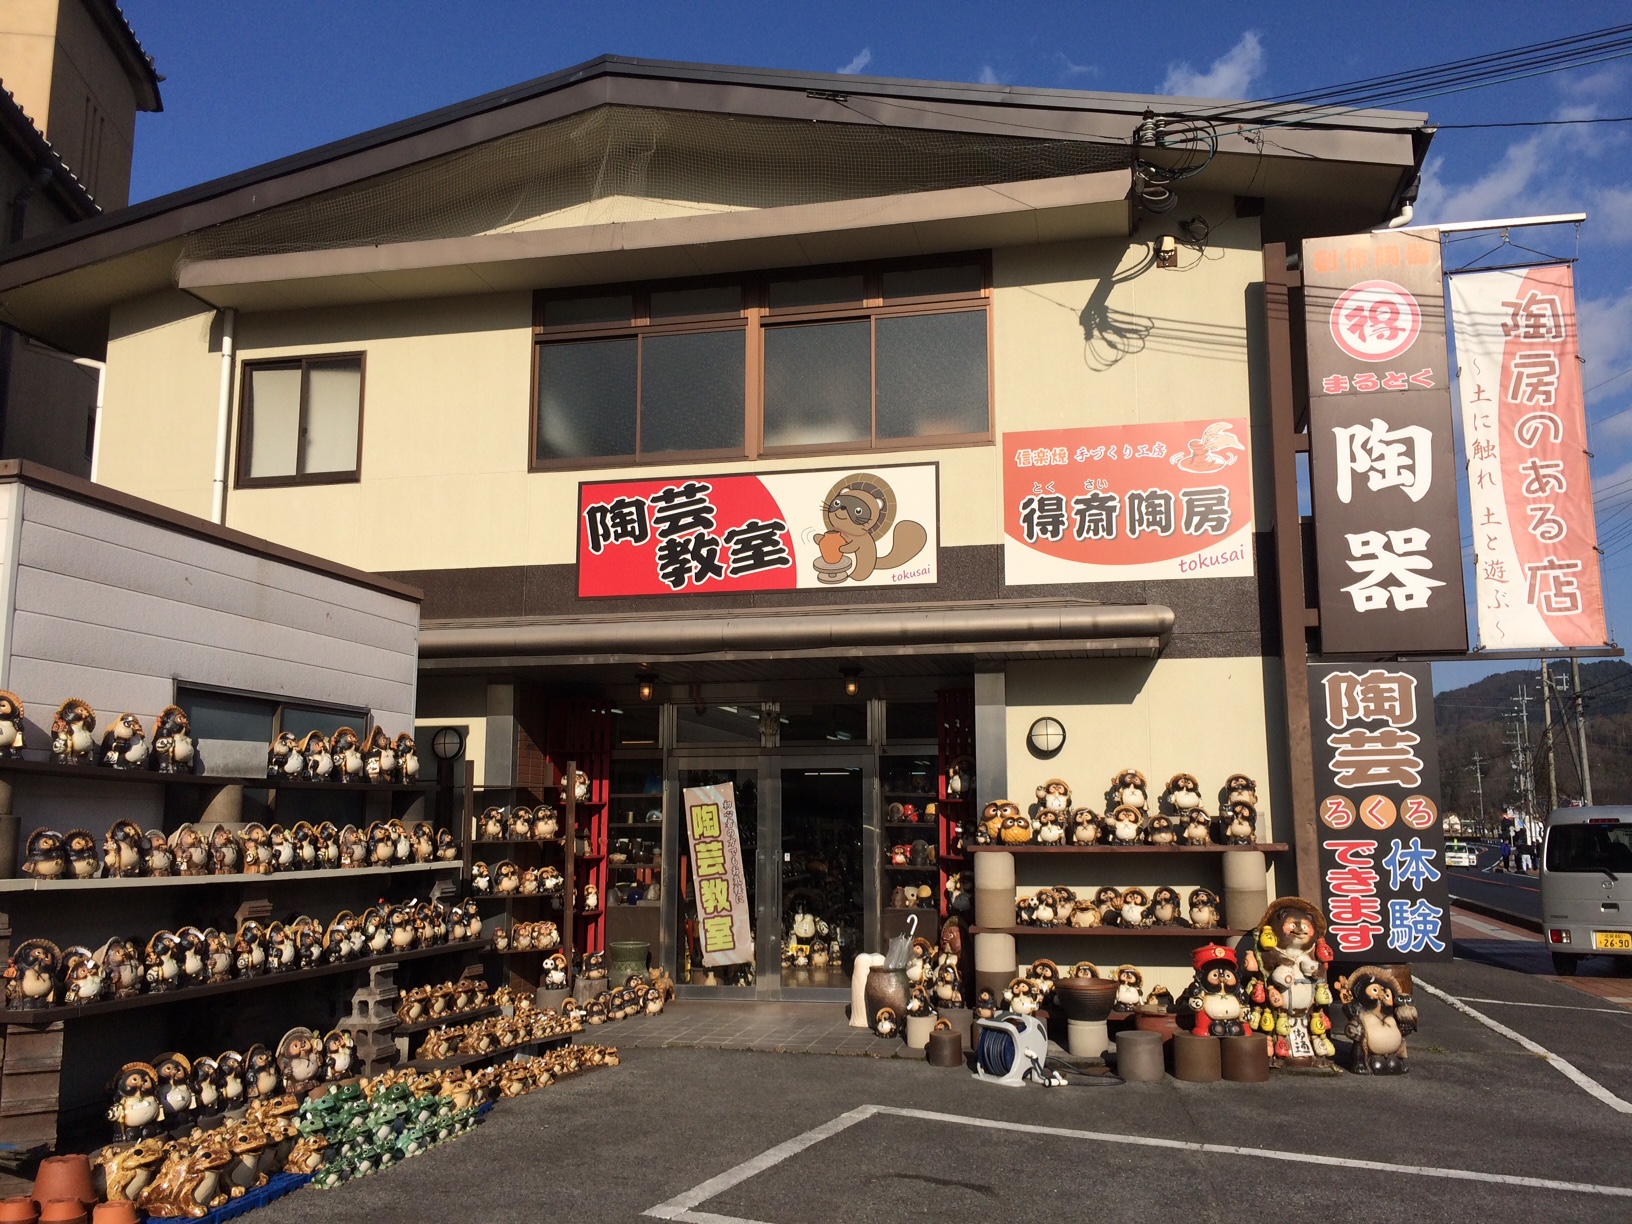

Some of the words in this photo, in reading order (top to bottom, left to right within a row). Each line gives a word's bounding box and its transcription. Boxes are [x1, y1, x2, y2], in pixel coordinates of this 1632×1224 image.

[1322, 368, 1435, 394] まるとく
[1015, 447, 1069, 467] 信楽焼
[1074, 442, 1167, 462] 手づくり工房
[1032, 481, 1055, 493] とく
[1084, 478, 1108, 491] さい
[1500, 289, 1582, 616] 陶房のある店
[584, 481, 716, 553] 陶芸
[1019, 485, 1233, 544] 得斎陶房
[1331, 418, 1447, 613] 陶器
[655, 519, 792, 591] 教室
[891, 564, 931, 583] tokusai
[1178, 544, 1245, 573] tokusai
[1321, 669, 1423, 788] 陶芸
[1324, 797, 1436, 828] ろくろ
[690, 803, 735, 953] 陶芸教室
[1323, 839, 1384, 953] できます
[1382, 837, 1446, 953] 体験
